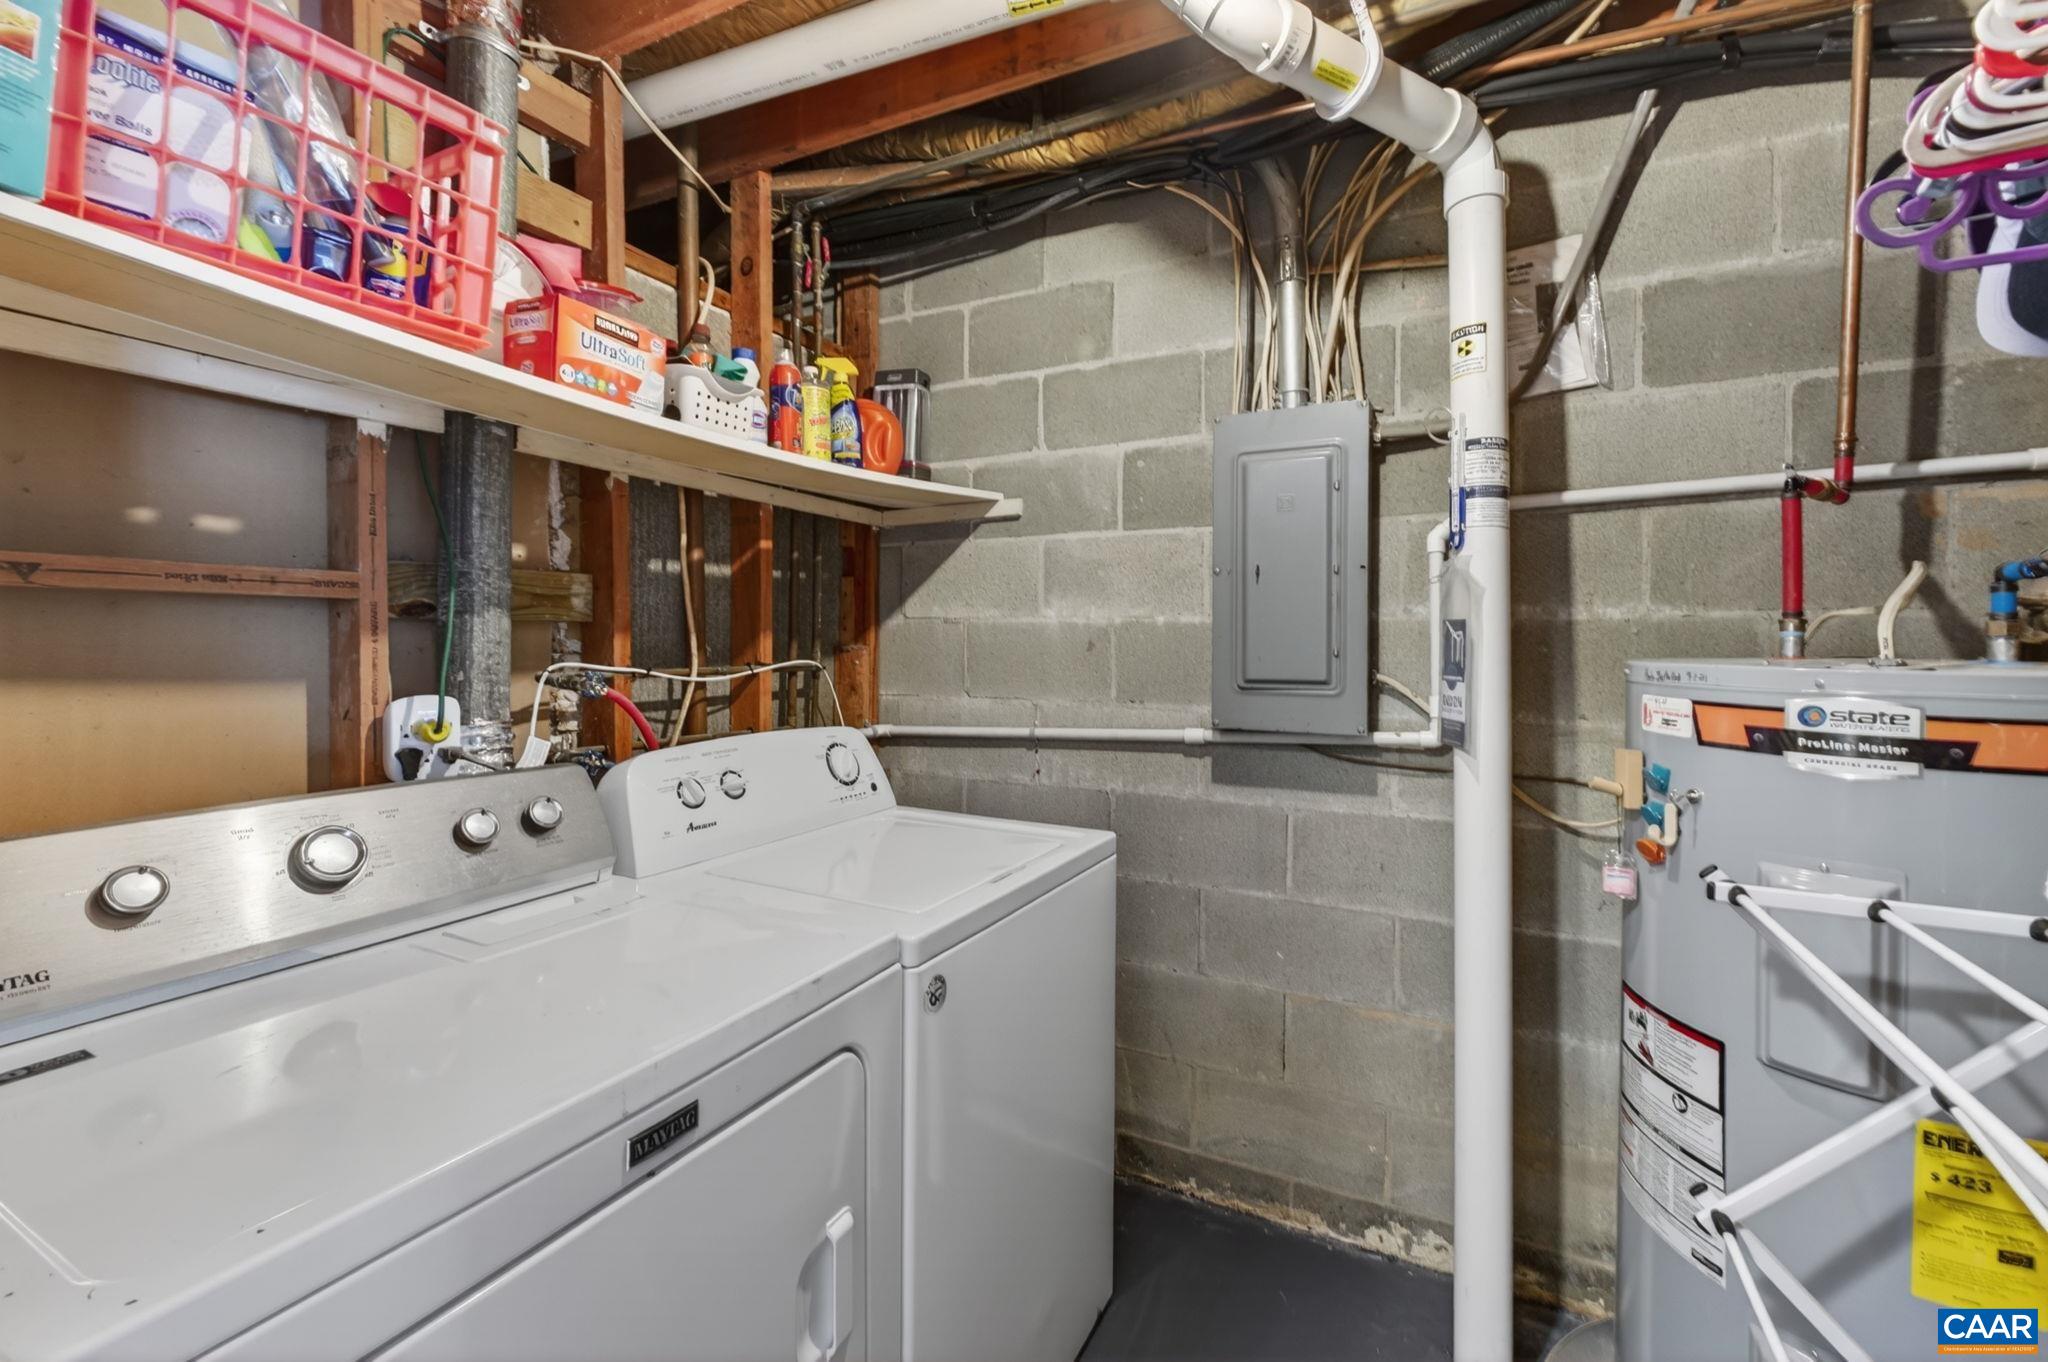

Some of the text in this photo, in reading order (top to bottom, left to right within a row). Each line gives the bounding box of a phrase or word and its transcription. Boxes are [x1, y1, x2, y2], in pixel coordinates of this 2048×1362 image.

[92, 54, 162, 94] oolite
[581, 331, 646, 371] UltraSoft
[1829, 709, 1911, 727] state
